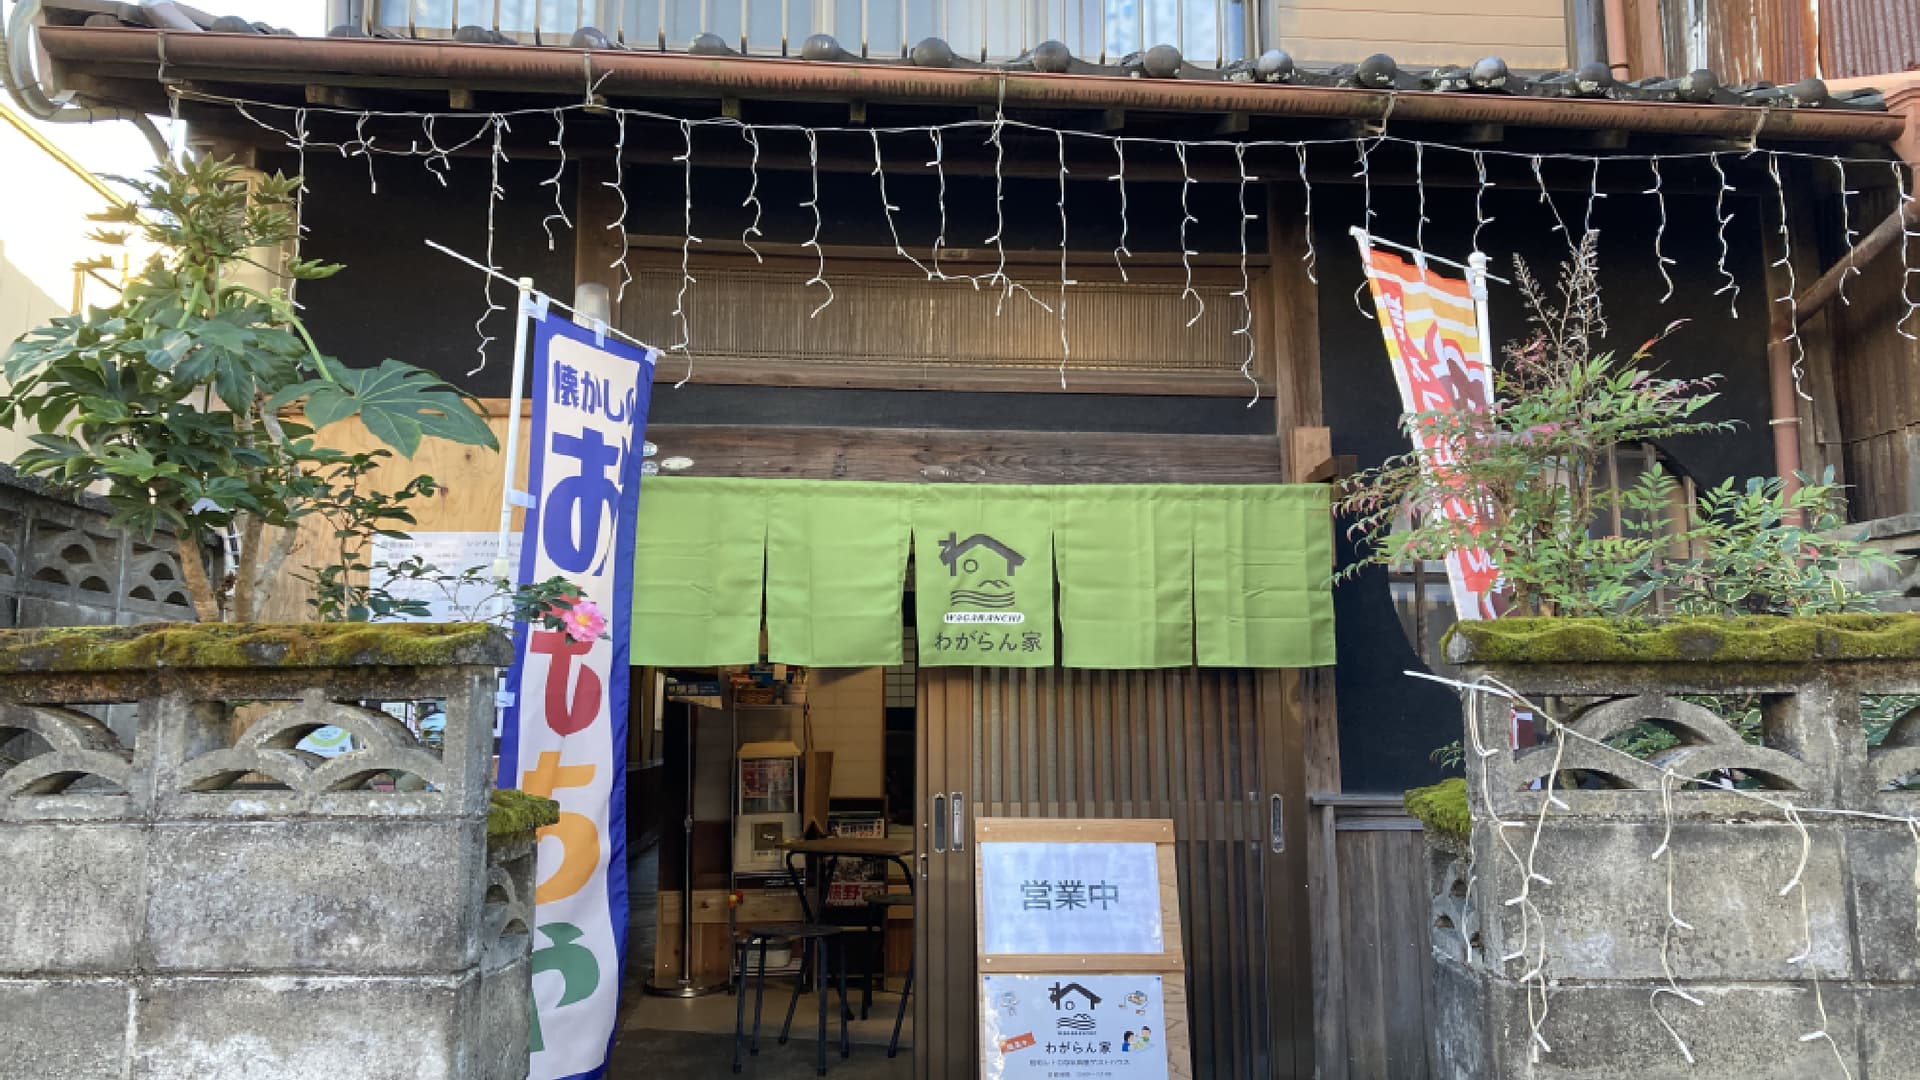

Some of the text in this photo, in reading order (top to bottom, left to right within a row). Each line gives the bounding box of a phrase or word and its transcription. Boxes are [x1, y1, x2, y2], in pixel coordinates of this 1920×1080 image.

[934, 630, 1043, 653] わがらん家
[1020, 880, 1120, 912] 営業中
[1045, 1041, 1112, 1055] わがらん家
